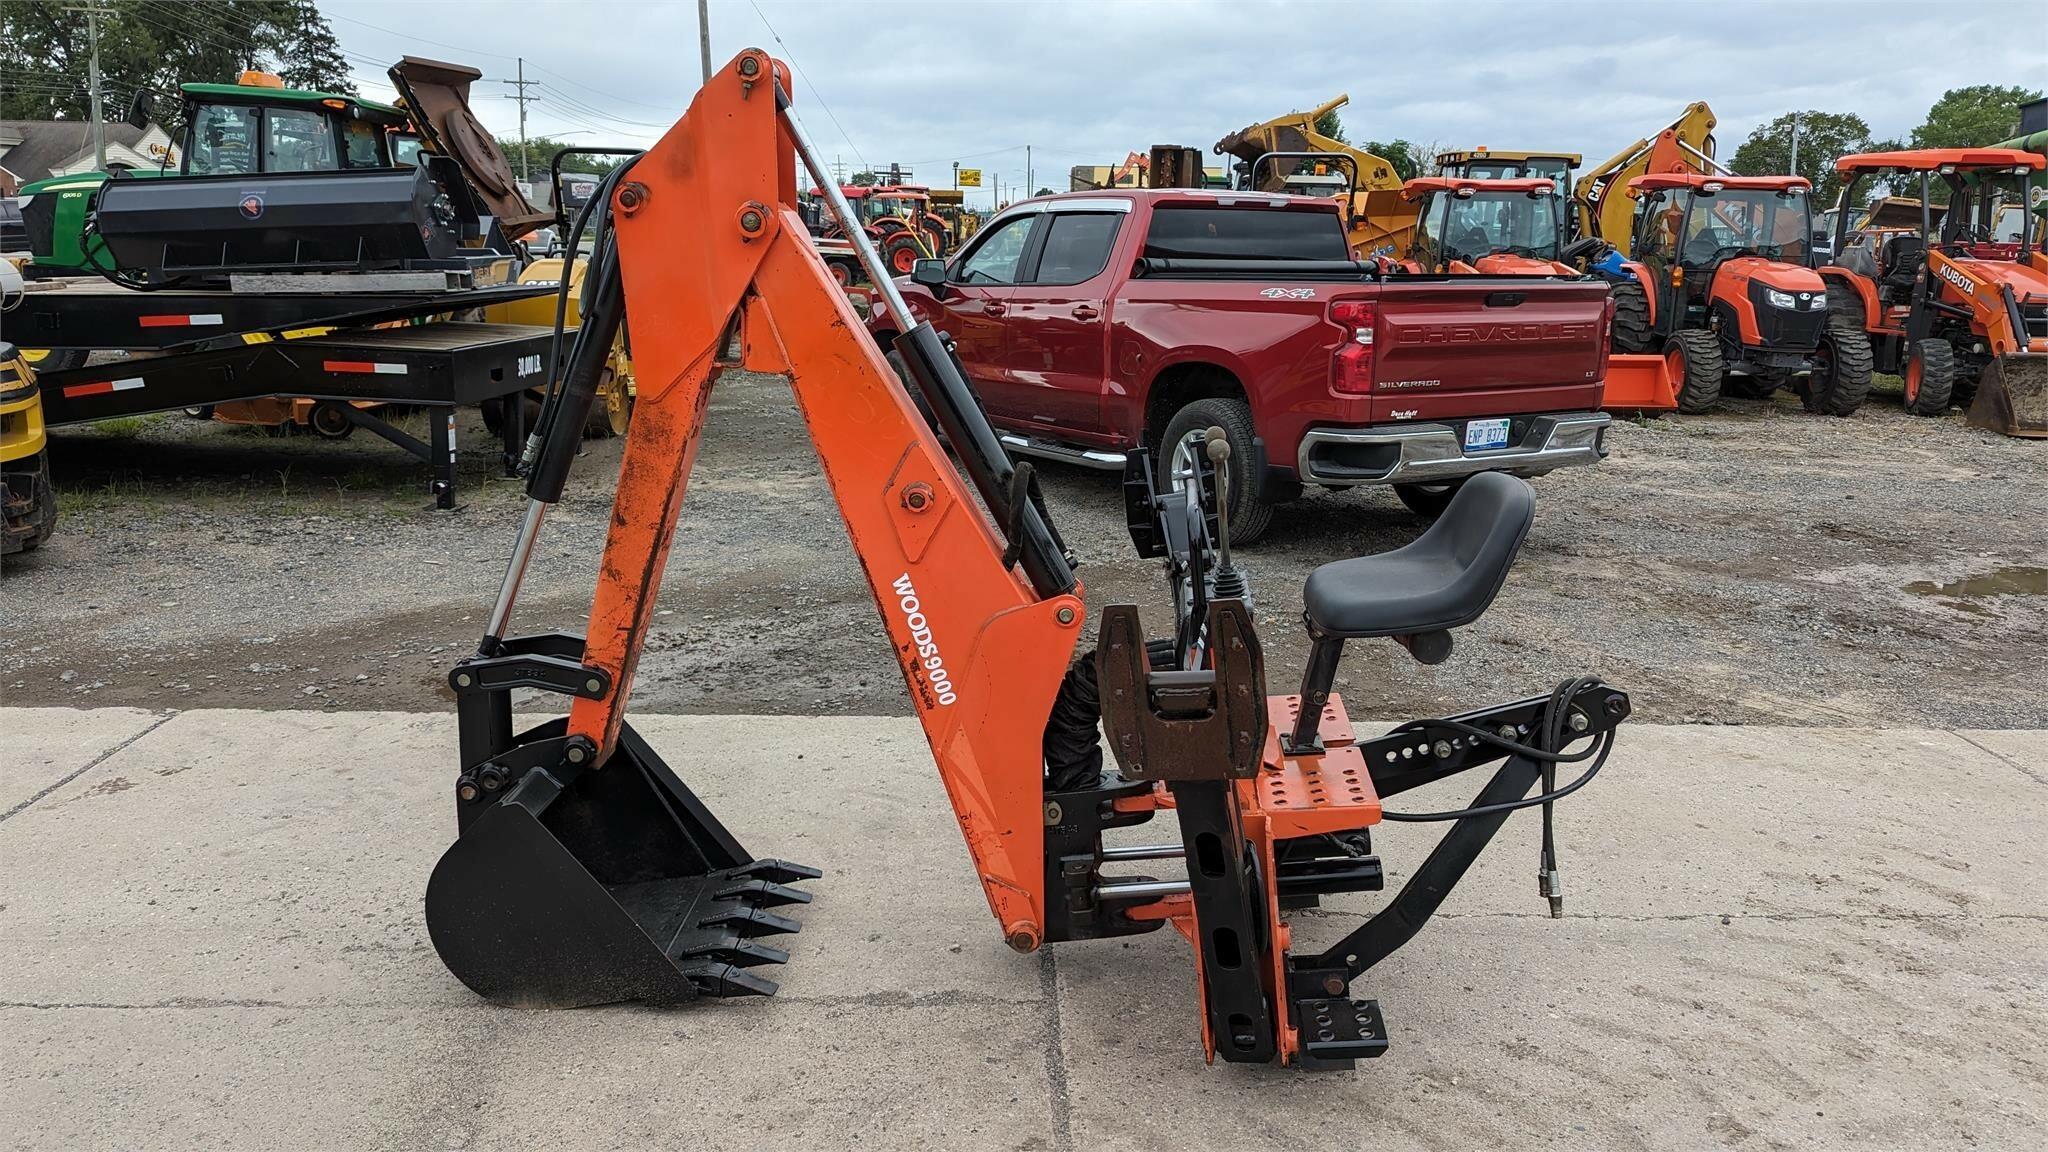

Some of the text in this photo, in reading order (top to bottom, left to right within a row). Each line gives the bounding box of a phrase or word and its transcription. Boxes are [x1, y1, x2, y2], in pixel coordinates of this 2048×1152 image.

[1588, 178, 1606, 202] CAT
[1940, 263, 1975, 295] KUBOTA
[1399, 324, 1594, 344] CHEVROLET
[1379, 379, 1441, 389] SILVERADO
[1468, 427, 1507, 444] ENP 8373
